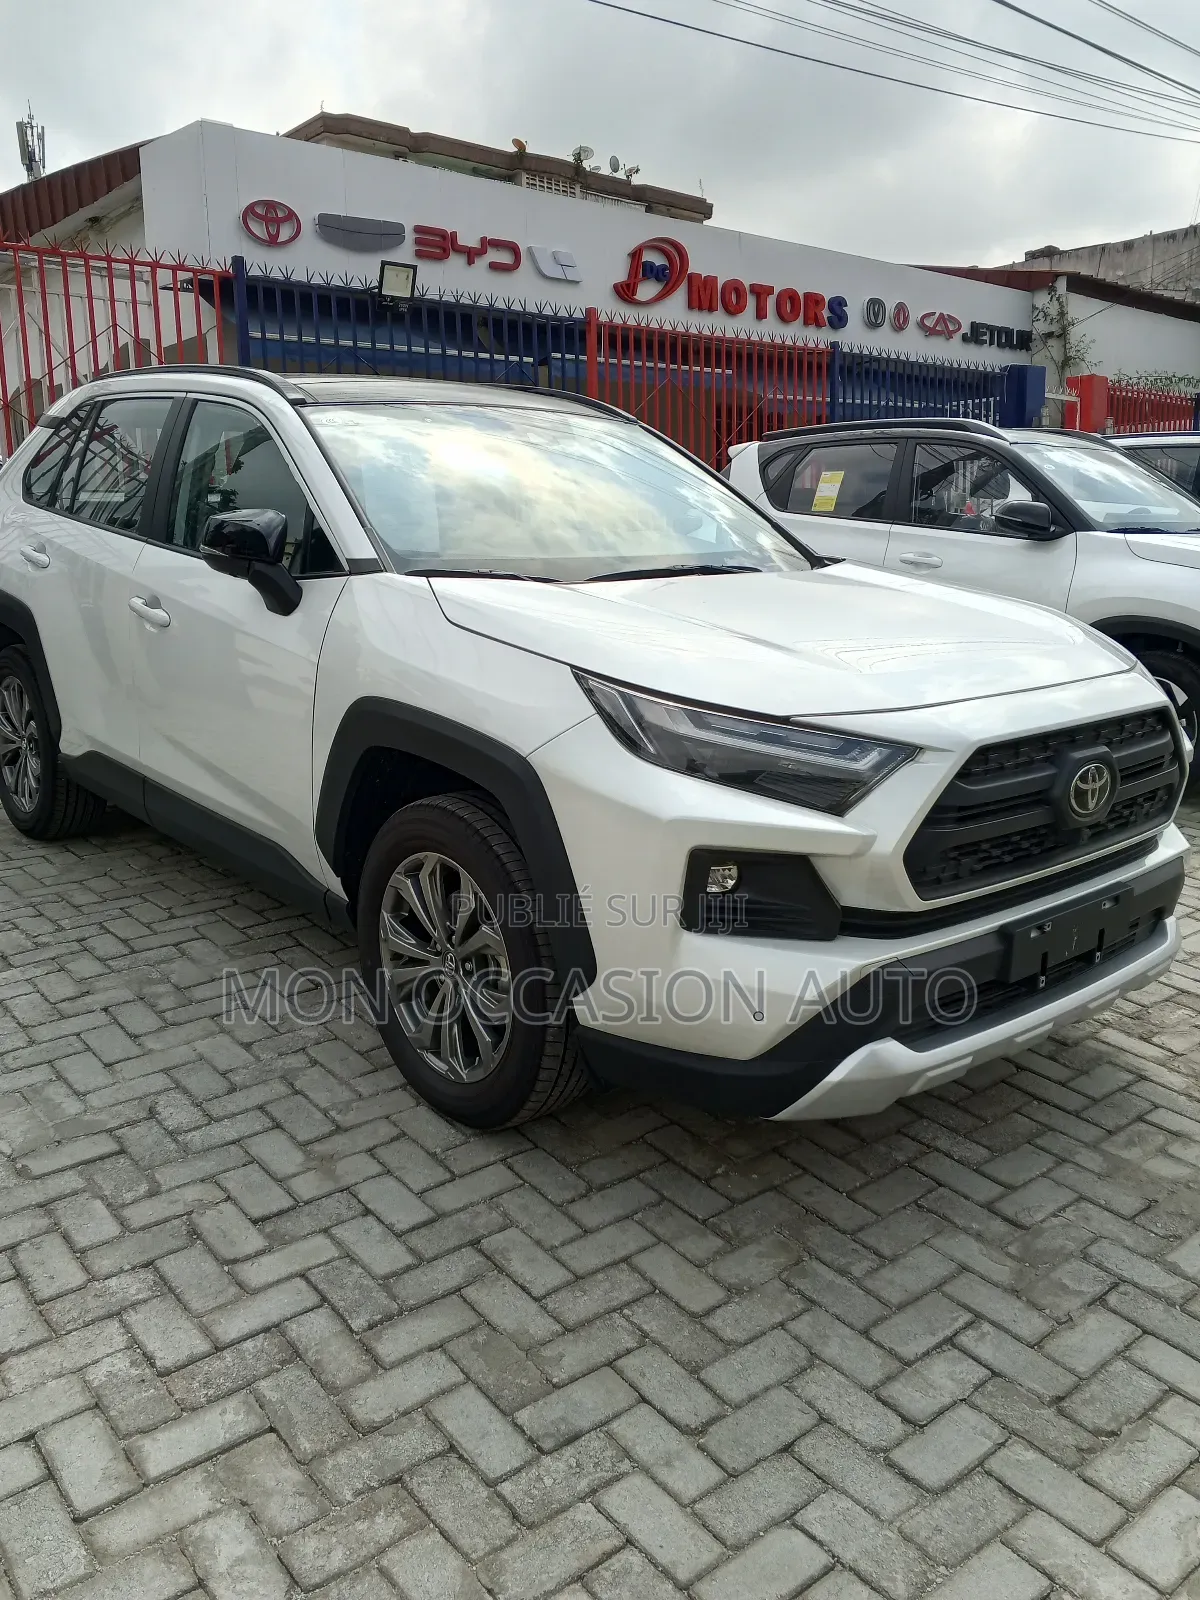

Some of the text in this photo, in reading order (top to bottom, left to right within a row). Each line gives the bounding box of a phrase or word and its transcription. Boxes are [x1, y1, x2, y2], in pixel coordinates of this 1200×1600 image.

[413, 224, 522, 272] BYD
[687, 272, 849, 330] MOTORS
[962, 321, 1032, 351] JETOUR
